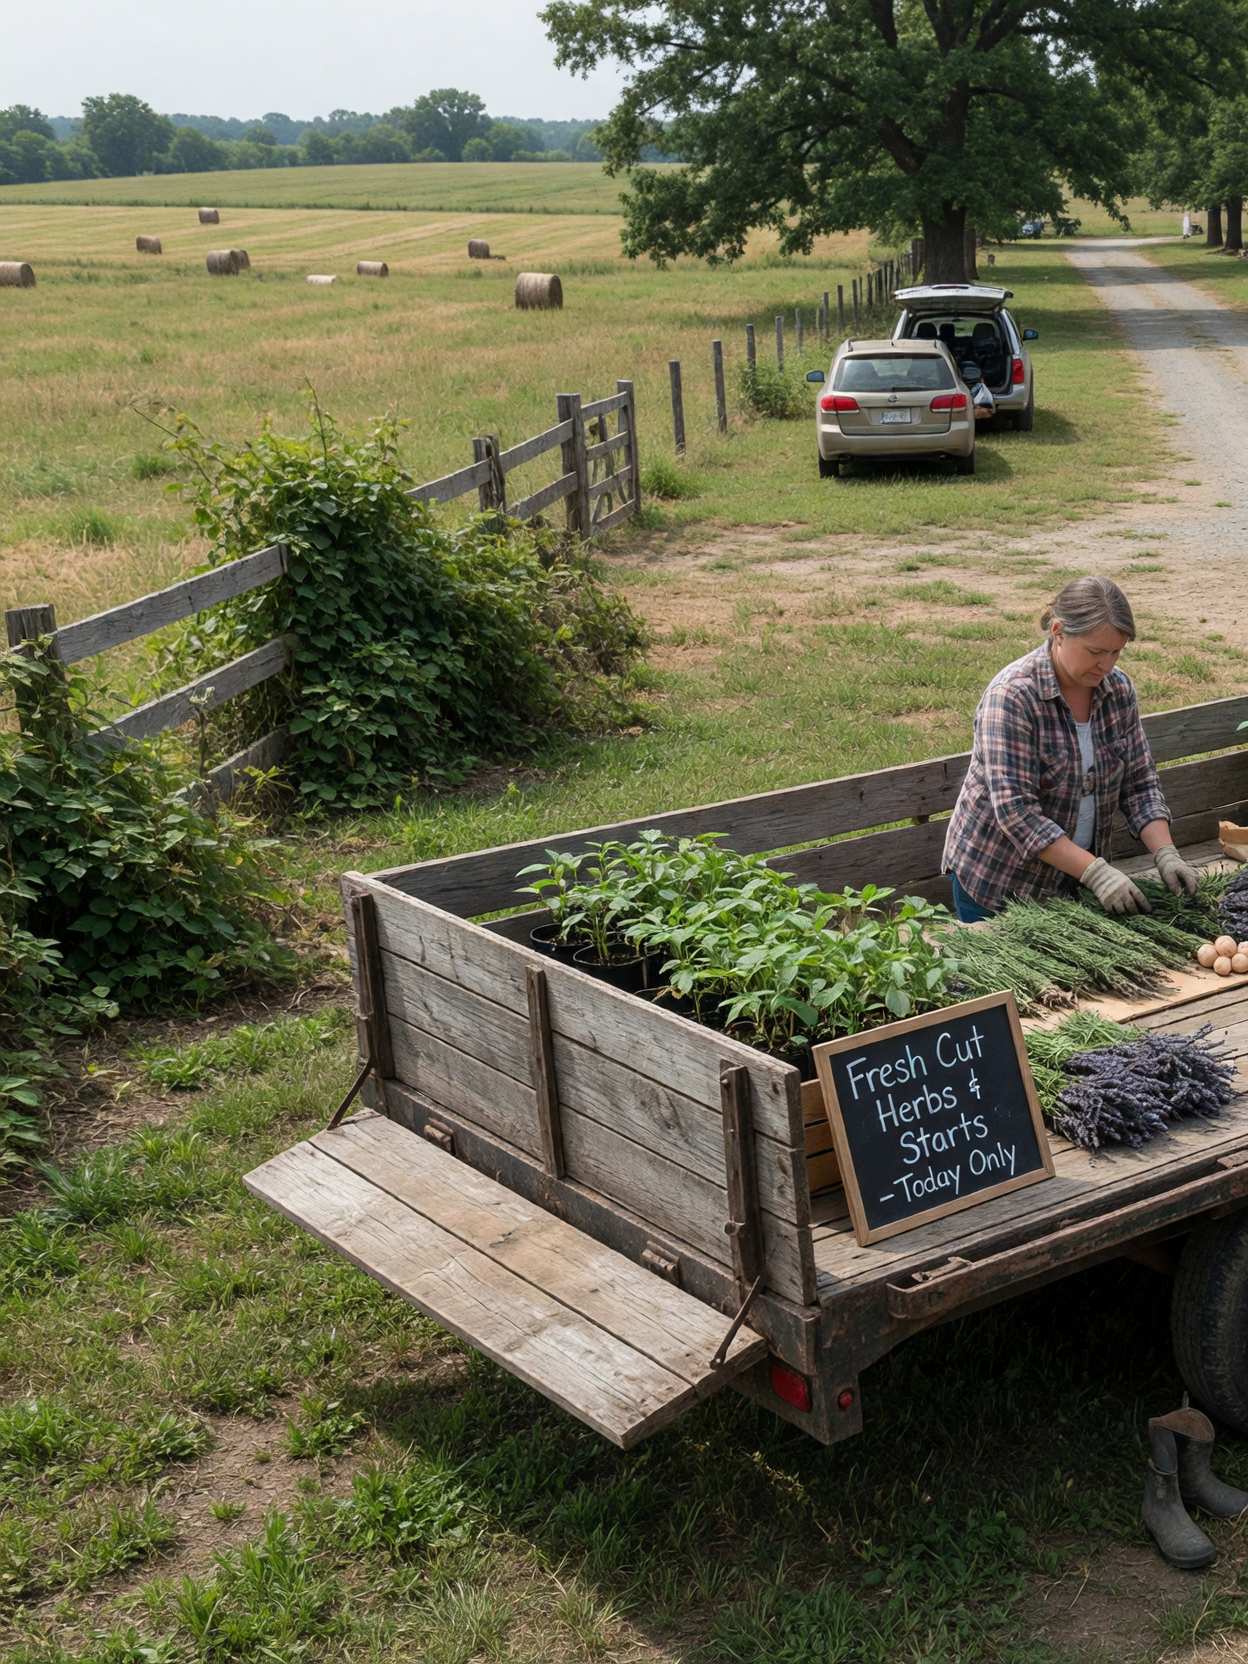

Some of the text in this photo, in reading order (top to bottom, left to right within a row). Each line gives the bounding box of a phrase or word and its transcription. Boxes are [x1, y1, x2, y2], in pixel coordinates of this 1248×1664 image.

[846, 1025, 985, 1100] Fresh Cut
[876, 1068, 981, 1133] Herbs &
[900, 1112, 989, 1165] Starts
[969, 1142, 1016, 1176] Only
